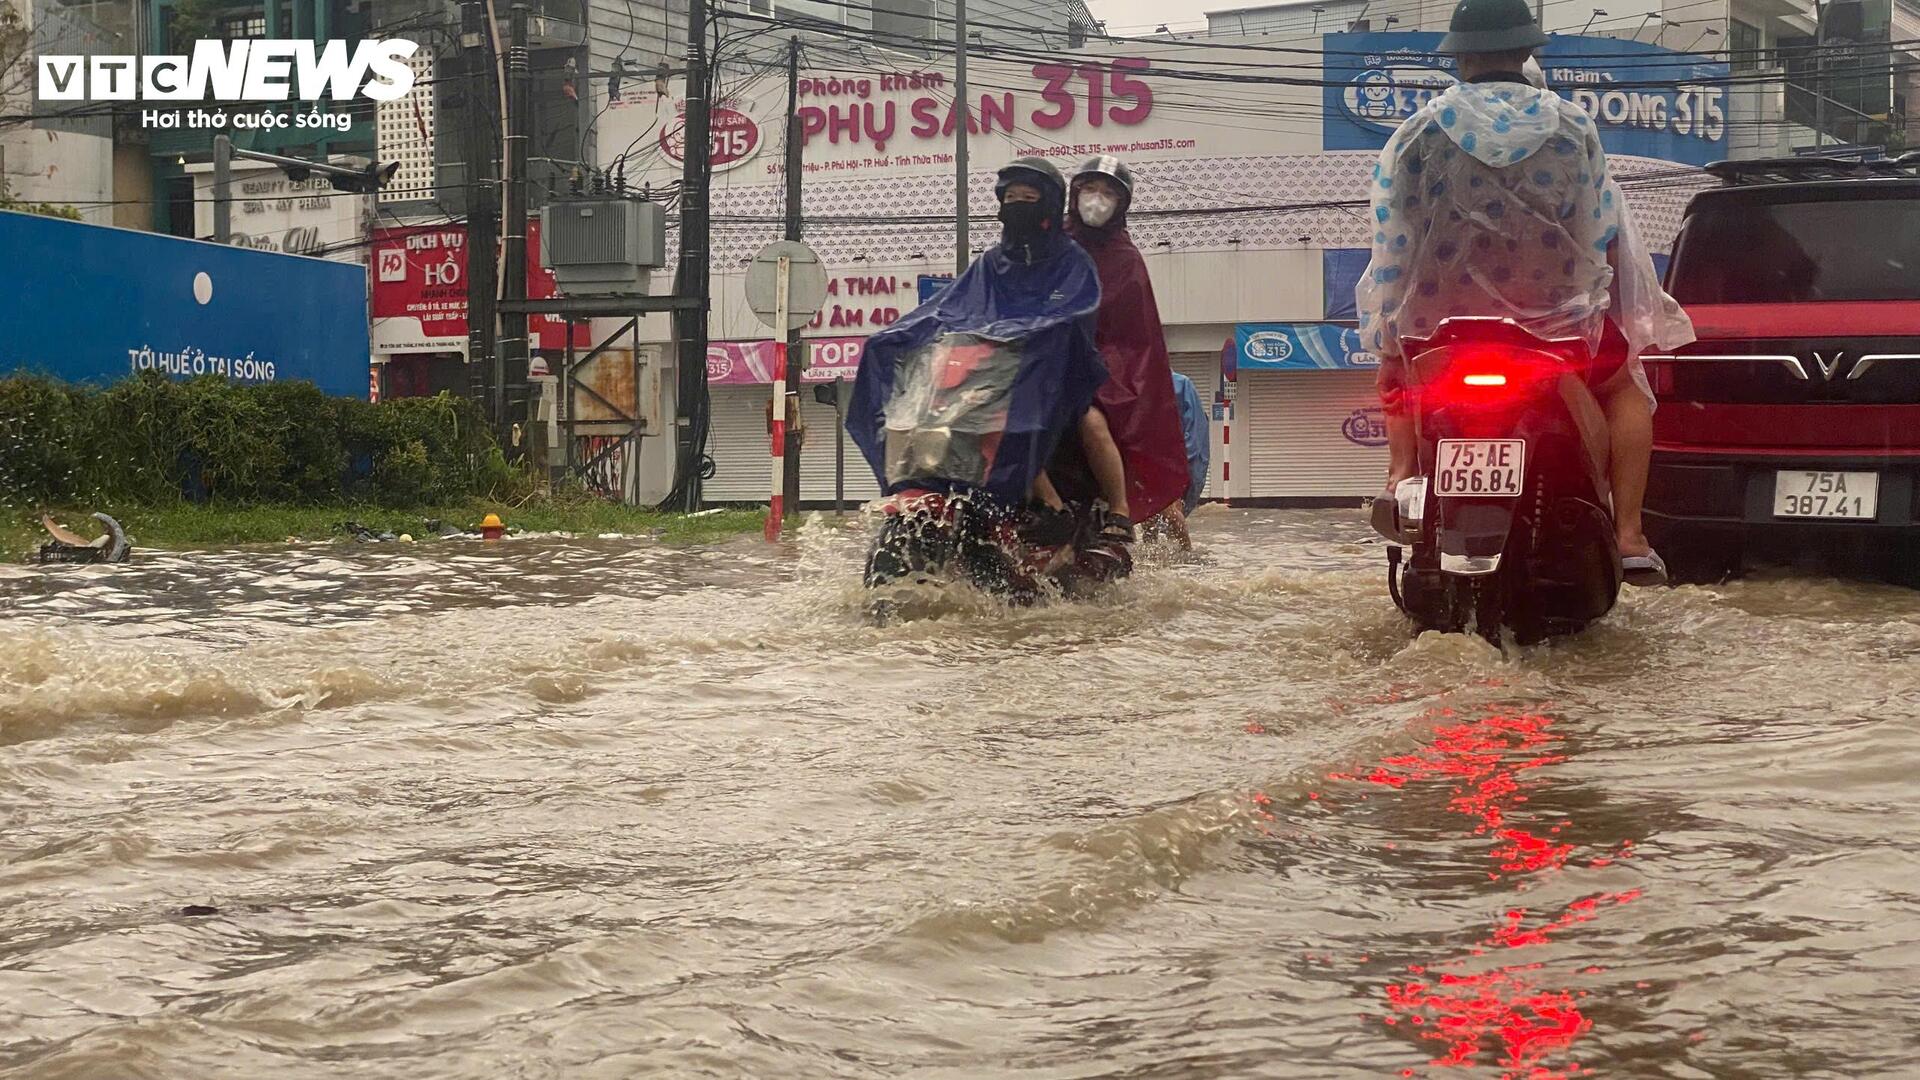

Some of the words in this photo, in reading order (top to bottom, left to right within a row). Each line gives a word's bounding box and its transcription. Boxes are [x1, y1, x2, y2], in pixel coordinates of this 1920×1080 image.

[798, 101, 895, 151] PHỤ
[1031, 57, 1153, 129] 315
[1671, 84, 1724, 141] 315
[406, 233, 437, 254] DỊCH
[441, 232, 463, 252] VỤ
[844, 276, 896, 296] THAI
[869, 307, 900, 325] 4D
[810, 343, 860, 365] TOP
[1267, 346, 1286, 356] 315
[709, 363, 728, 374] 315
[1451, 443, 1512, 467] 75-AE
[1440, 469, 1516, 493] 056.84
[1805, 472, 1847, 494] 75A
[1784, 495, 1862, 516] 387.41
